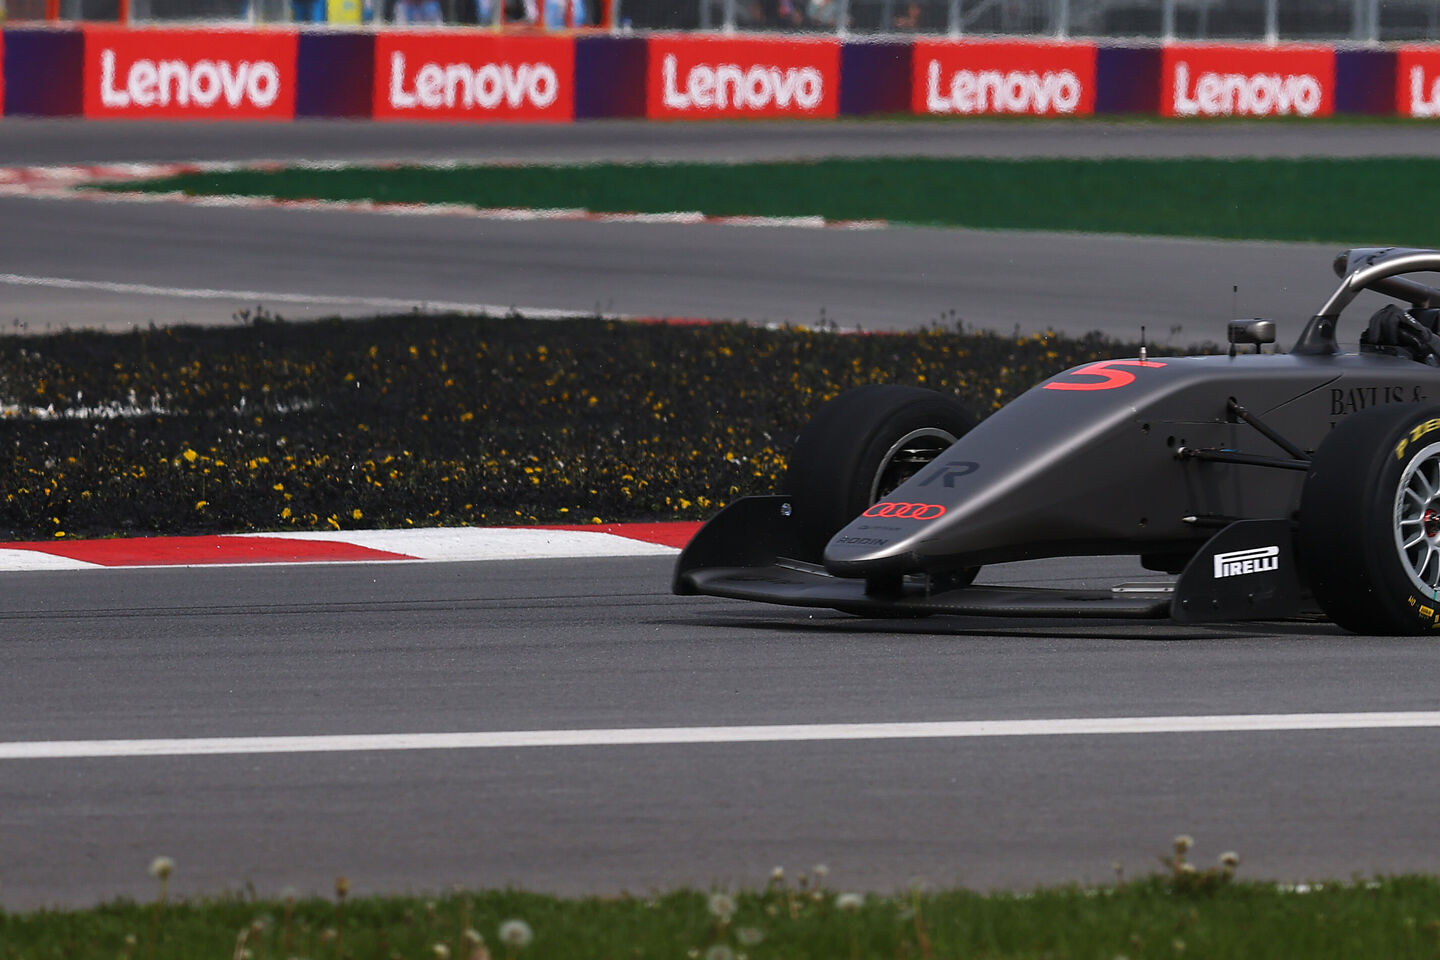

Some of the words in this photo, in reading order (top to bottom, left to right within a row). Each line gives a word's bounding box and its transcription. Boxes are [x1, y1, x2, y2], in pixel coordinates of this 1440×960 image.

[101, 50, 279, 108] Lenovo
[391, 51, 558, 109] Lenovo
[663, 53, 822, 110] Lenovo
[926, 59, 1080, 114] Lenovo
[1173, 64, 1322, 117] Lenovo
[1042, 360, 1168, 391] 5
[1213, 545, 1279, 578] PIRELLI
